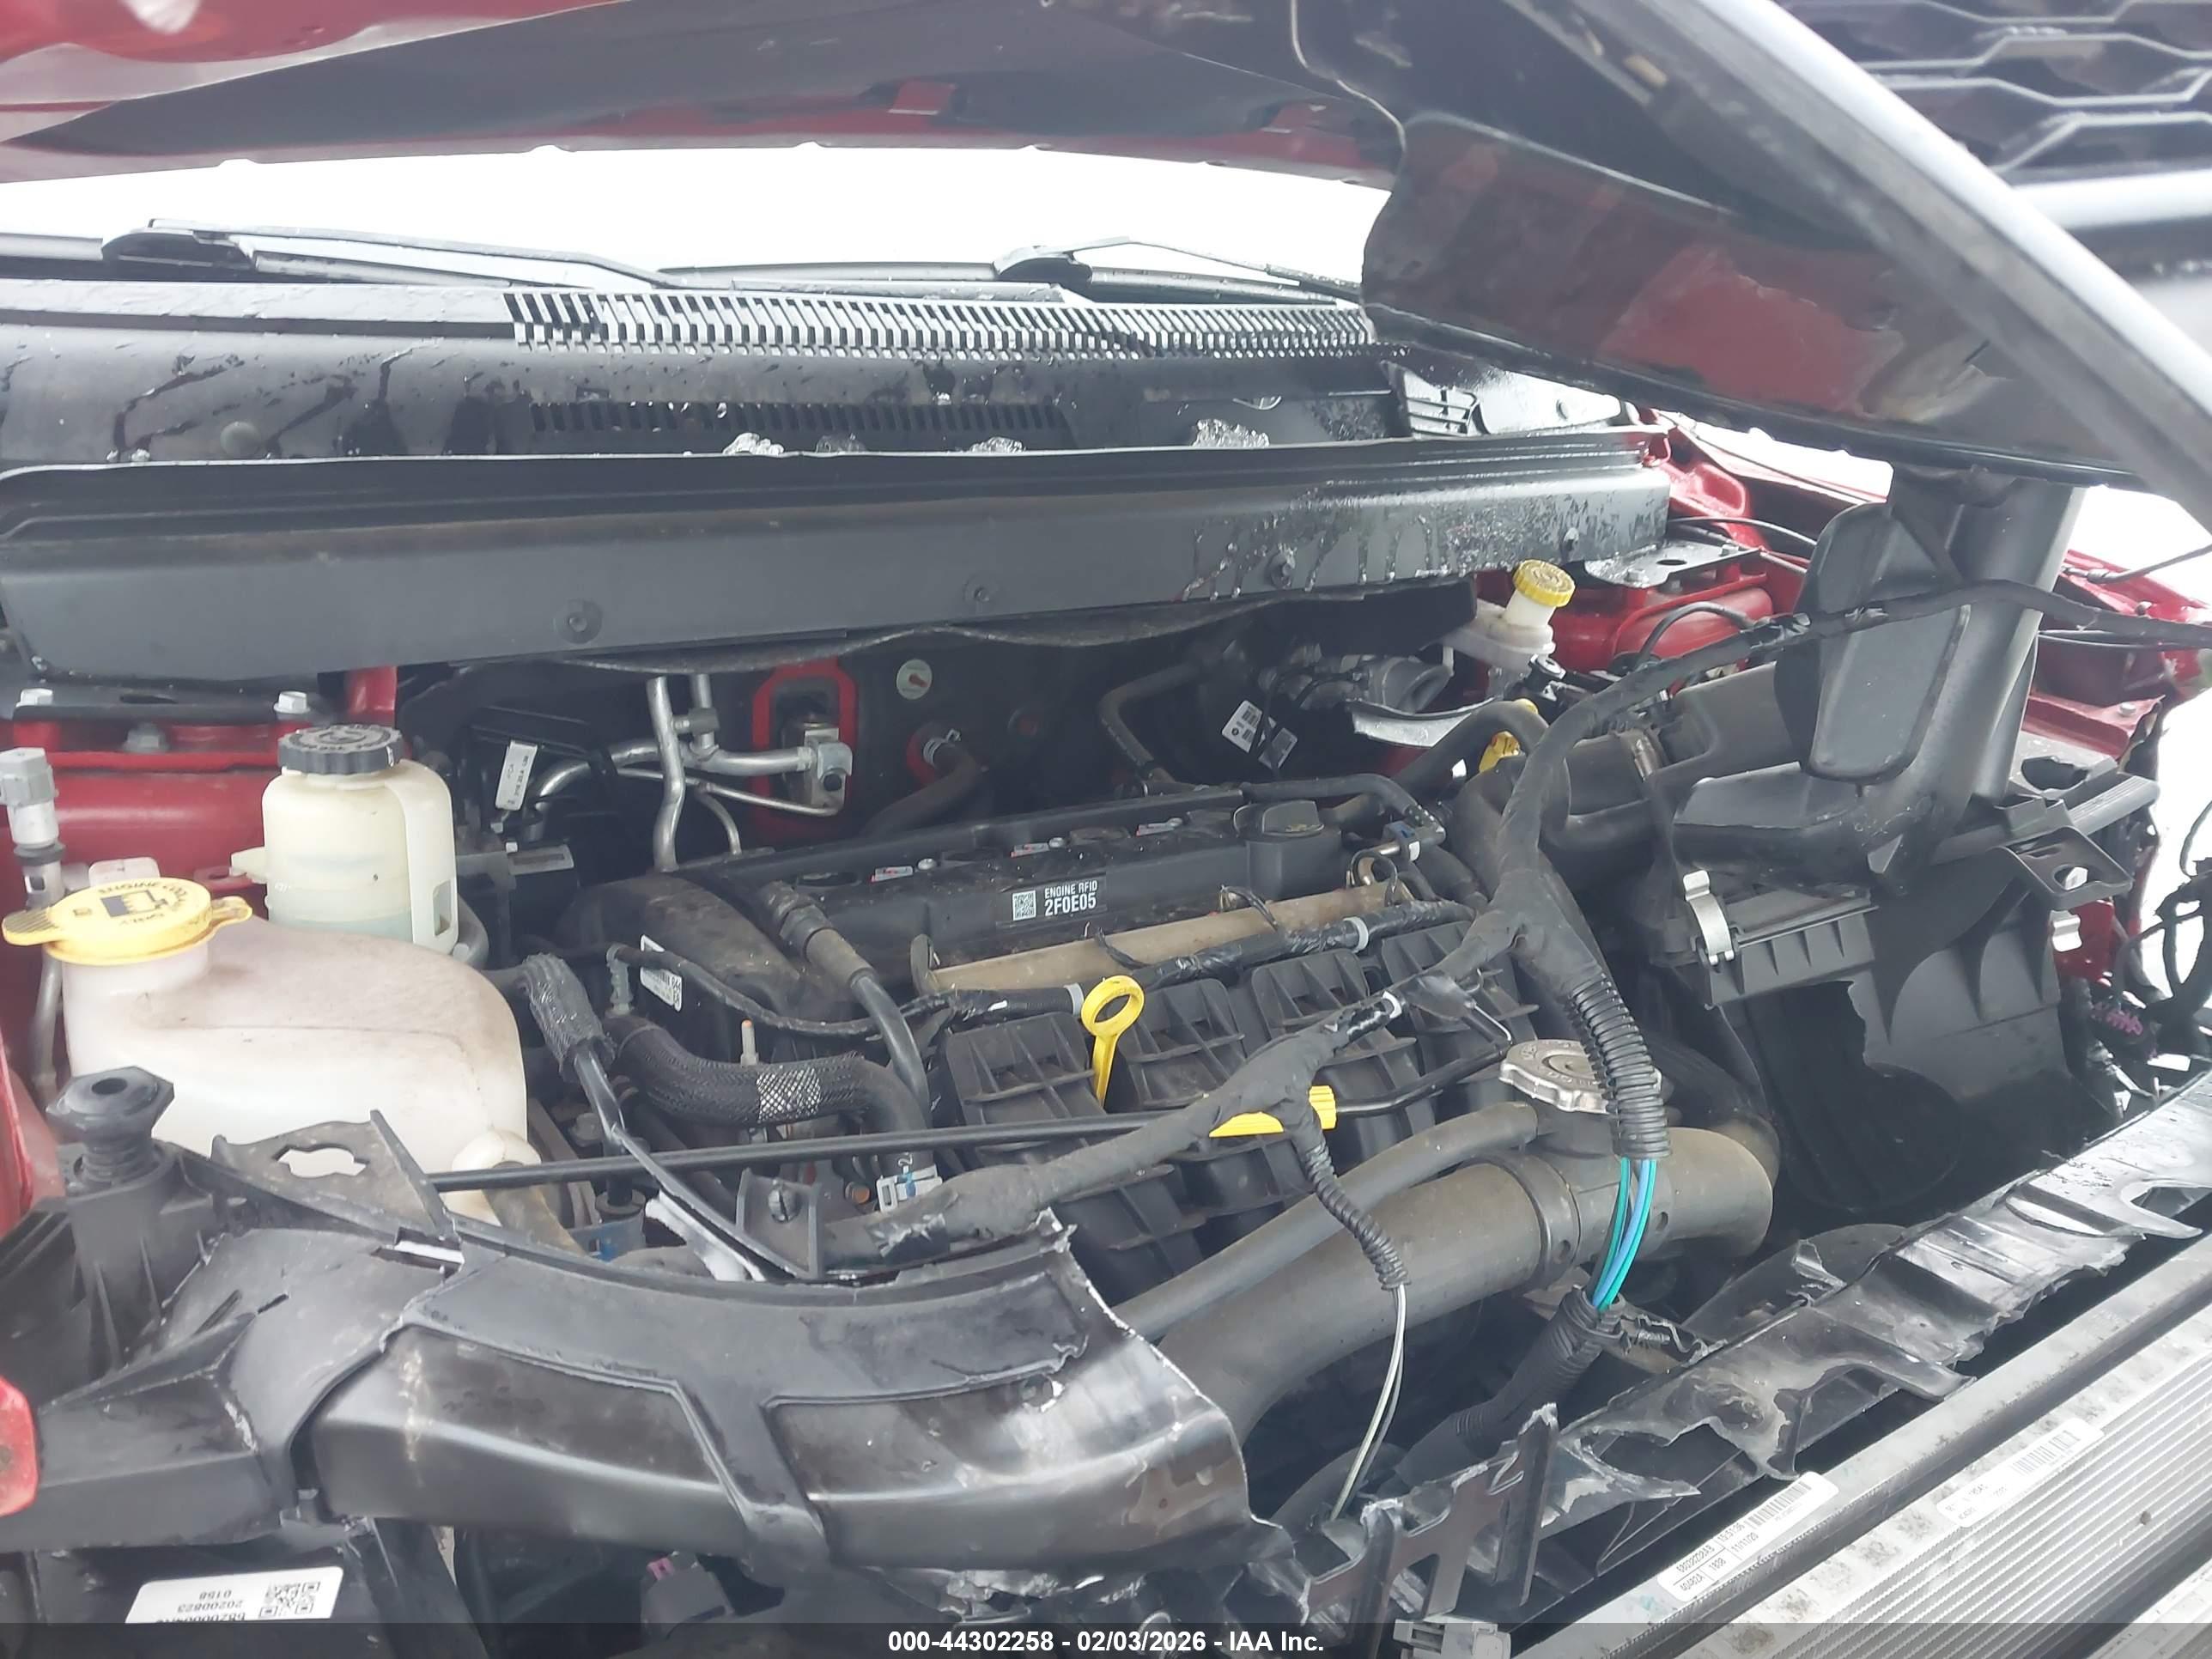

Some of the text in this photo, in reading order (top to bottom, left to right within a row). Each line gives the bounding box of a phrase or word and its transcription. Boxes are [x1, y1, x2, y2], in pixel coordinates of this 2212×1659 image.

[1044, 879, 1098, 899] ENGINE RFID
[1044, 891, 1097, 917] 2F0E05
